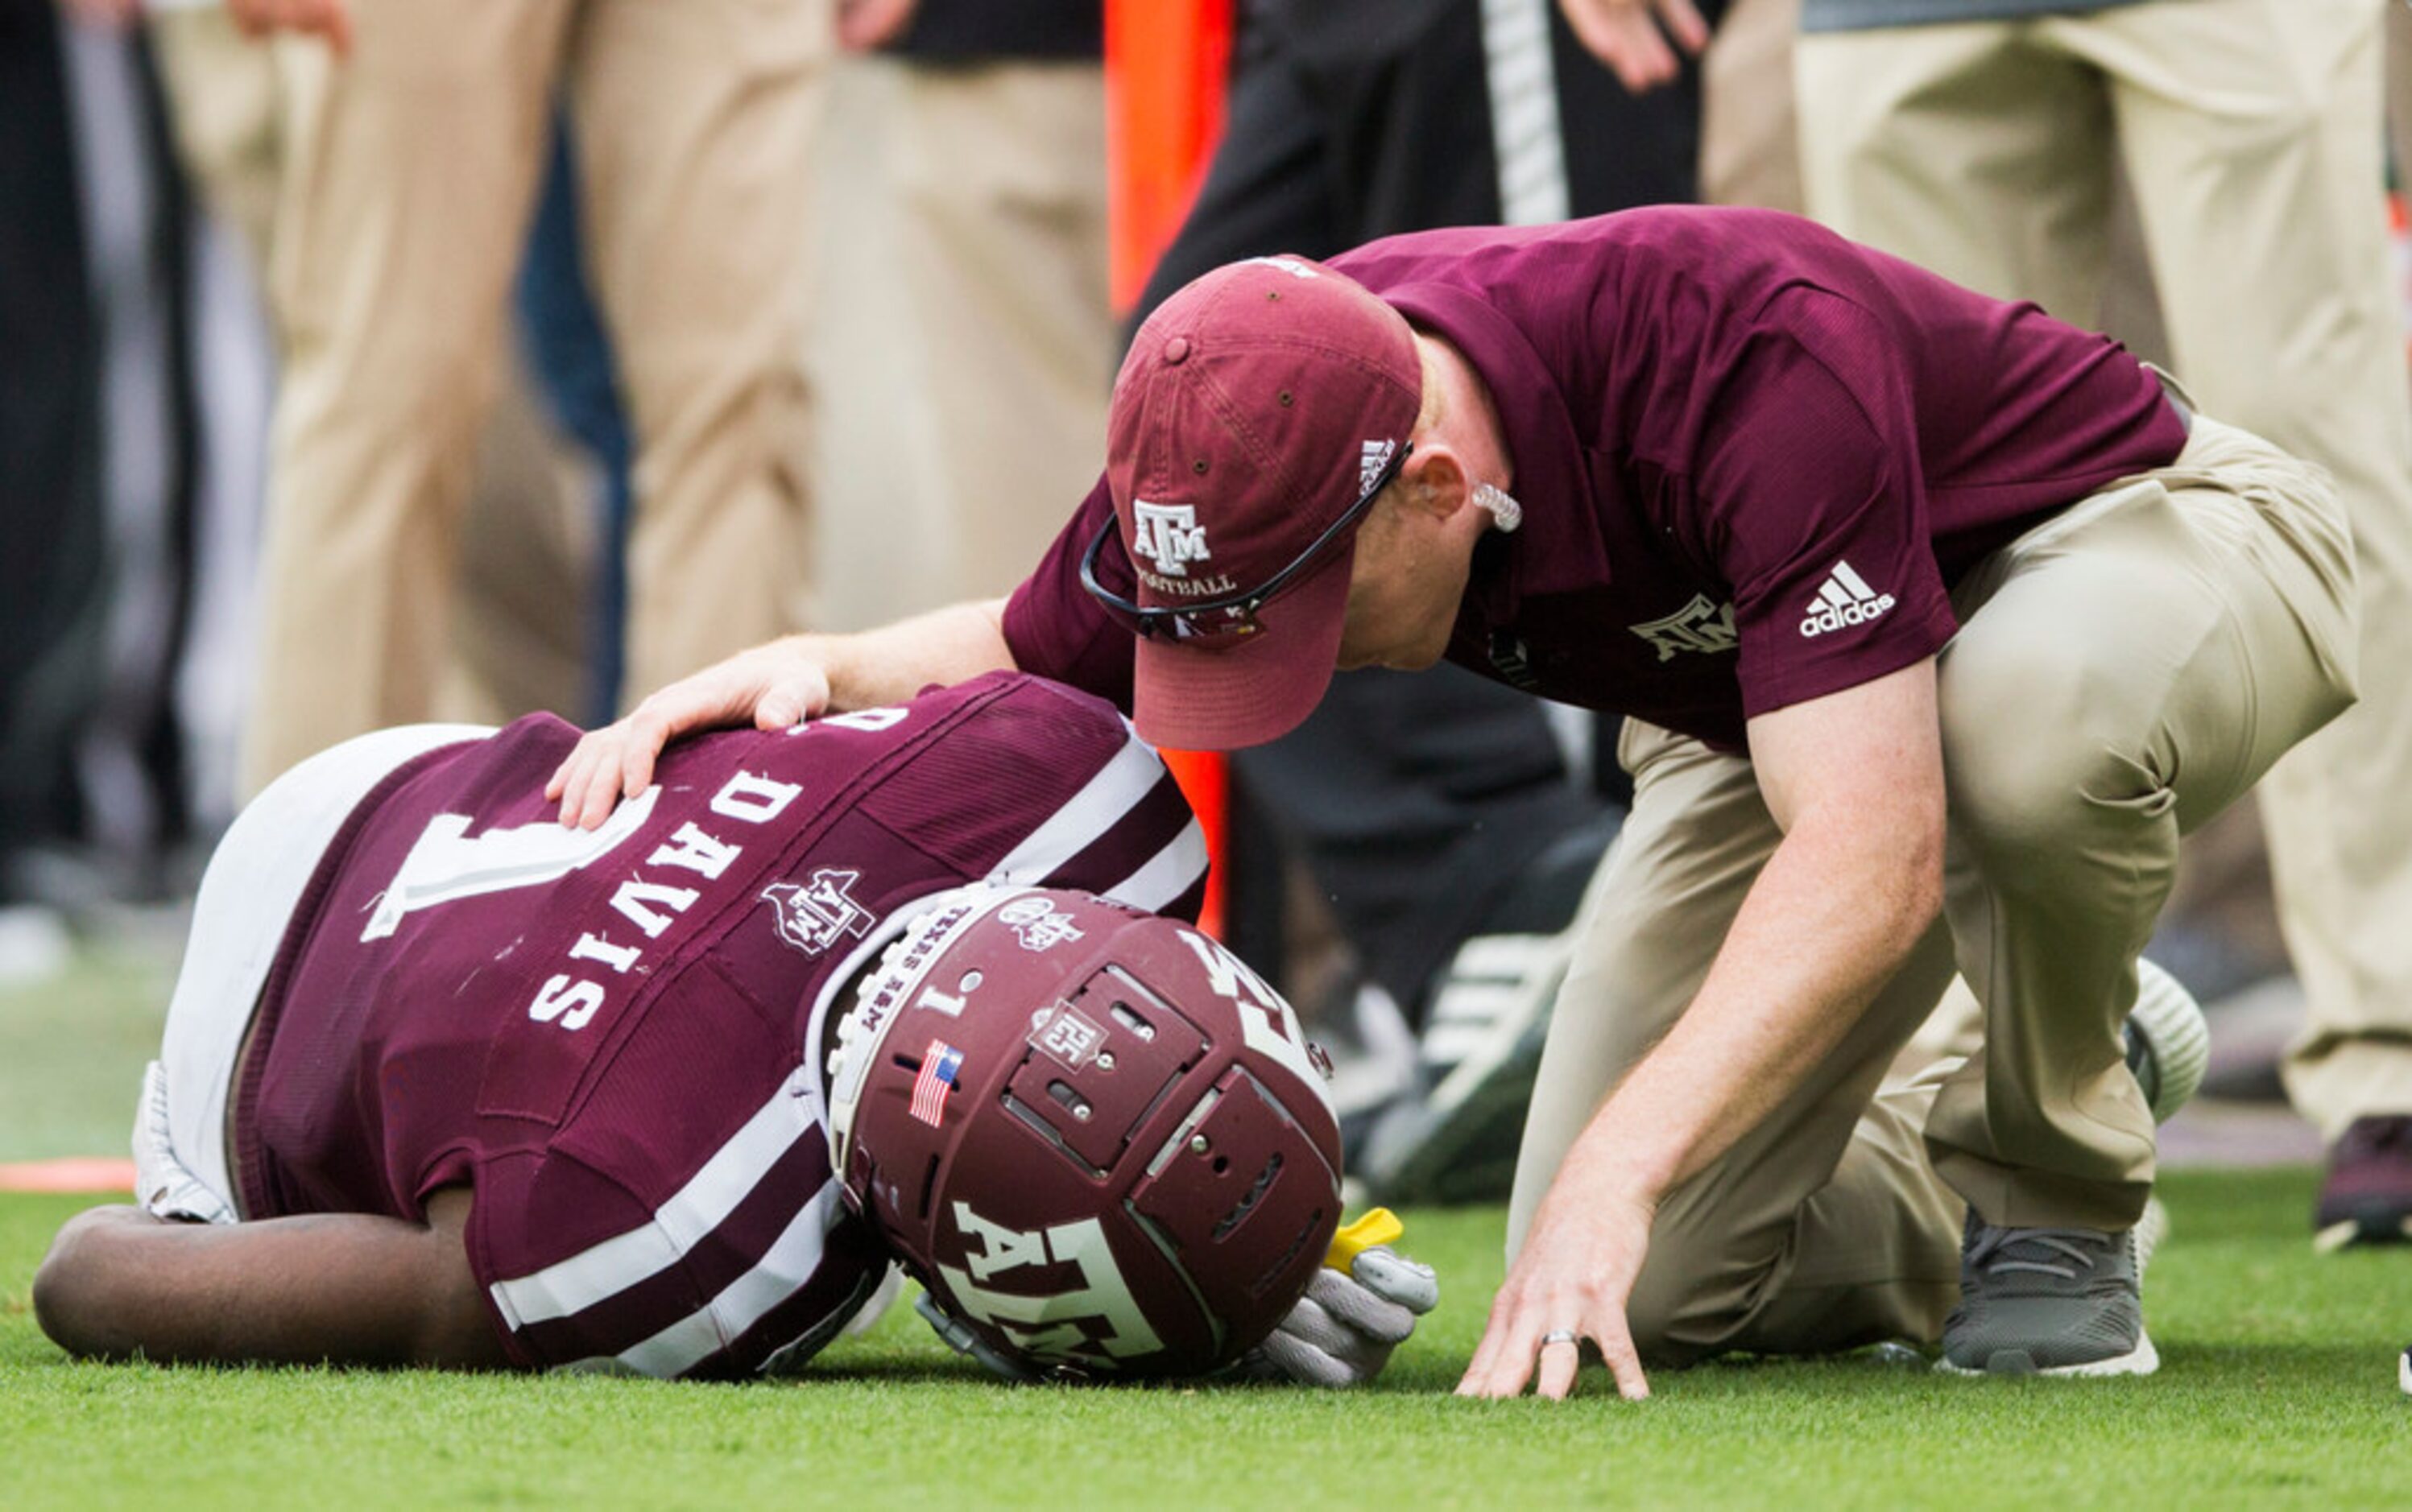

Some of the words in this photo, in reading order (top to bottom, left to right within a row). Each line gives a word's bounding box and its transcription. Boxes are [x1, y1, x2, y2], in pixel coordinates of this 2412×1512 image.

[1800, 593, 1896, 638] adidas
[529, 770, 803, 1031] DAVIS
[914, 984, 966, 1018] 1
